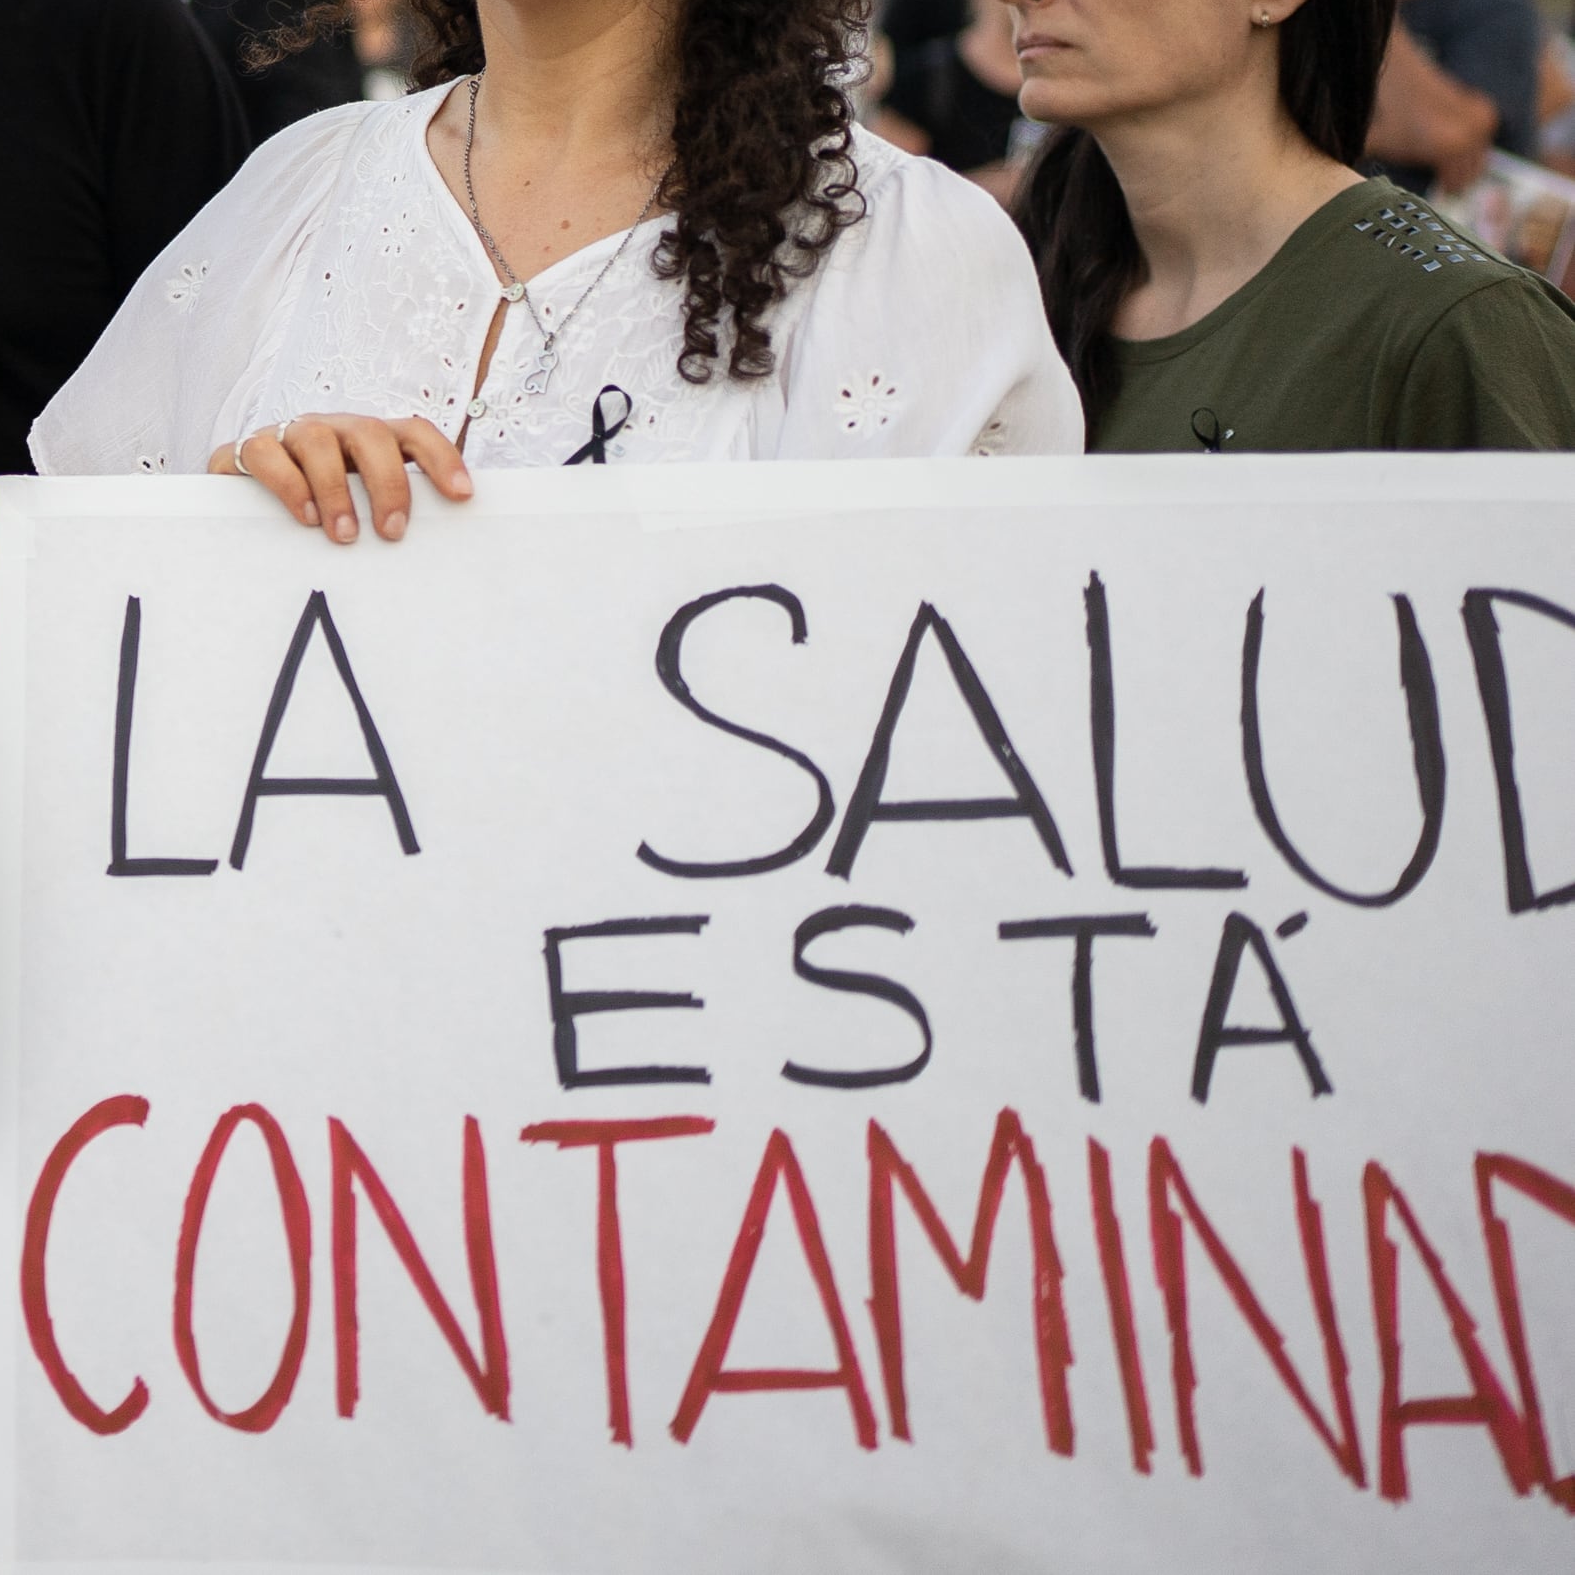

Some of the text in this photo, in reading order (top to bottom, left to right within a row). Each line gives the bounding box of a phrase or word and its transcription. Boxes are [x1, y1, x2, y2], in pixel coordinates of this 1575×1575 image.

[106, 569, 1575, 915] LA SALUD
[541, 904, 1334, 1103] ESTÁ
